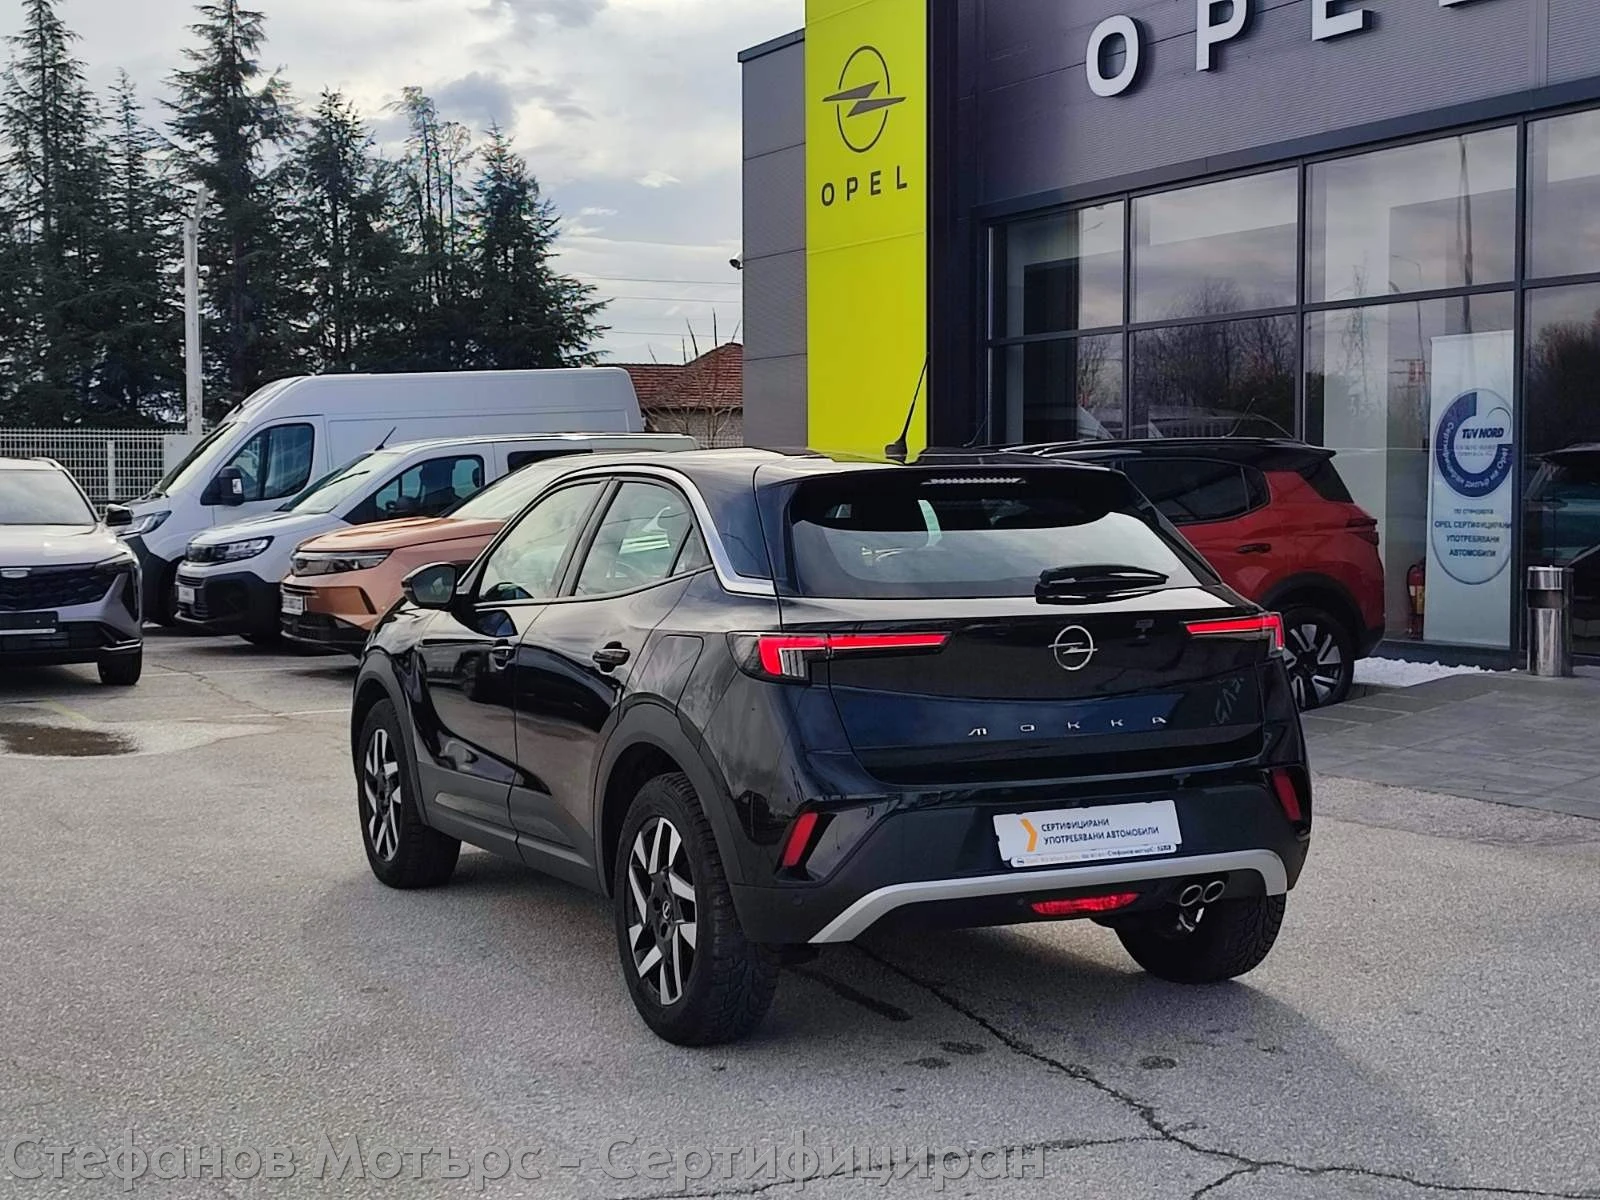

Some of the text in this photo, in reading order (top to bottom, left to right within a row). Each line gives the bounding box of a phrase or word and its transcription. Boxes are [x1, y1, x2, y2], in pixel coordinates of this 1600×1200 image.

[821, 165, 907, 206] OPEL
[1479, 427, 1504, 438] NORD
[1434, 521, 1452, 529] OPEL
[1446, 535, 1500, 543] УПОТРЕБЯВАНИ
[1449, 549, 1496, 557] АВТОМОБИЛИ
[968, 716, 1167, 736] MOKKA
[1041, 818, 1110, 832] СЕРТИФИЦИРАНИ
[1044, 826, 1160, 845] УПОТРЕБЯВАНИ АВТОМОБИЛИ
